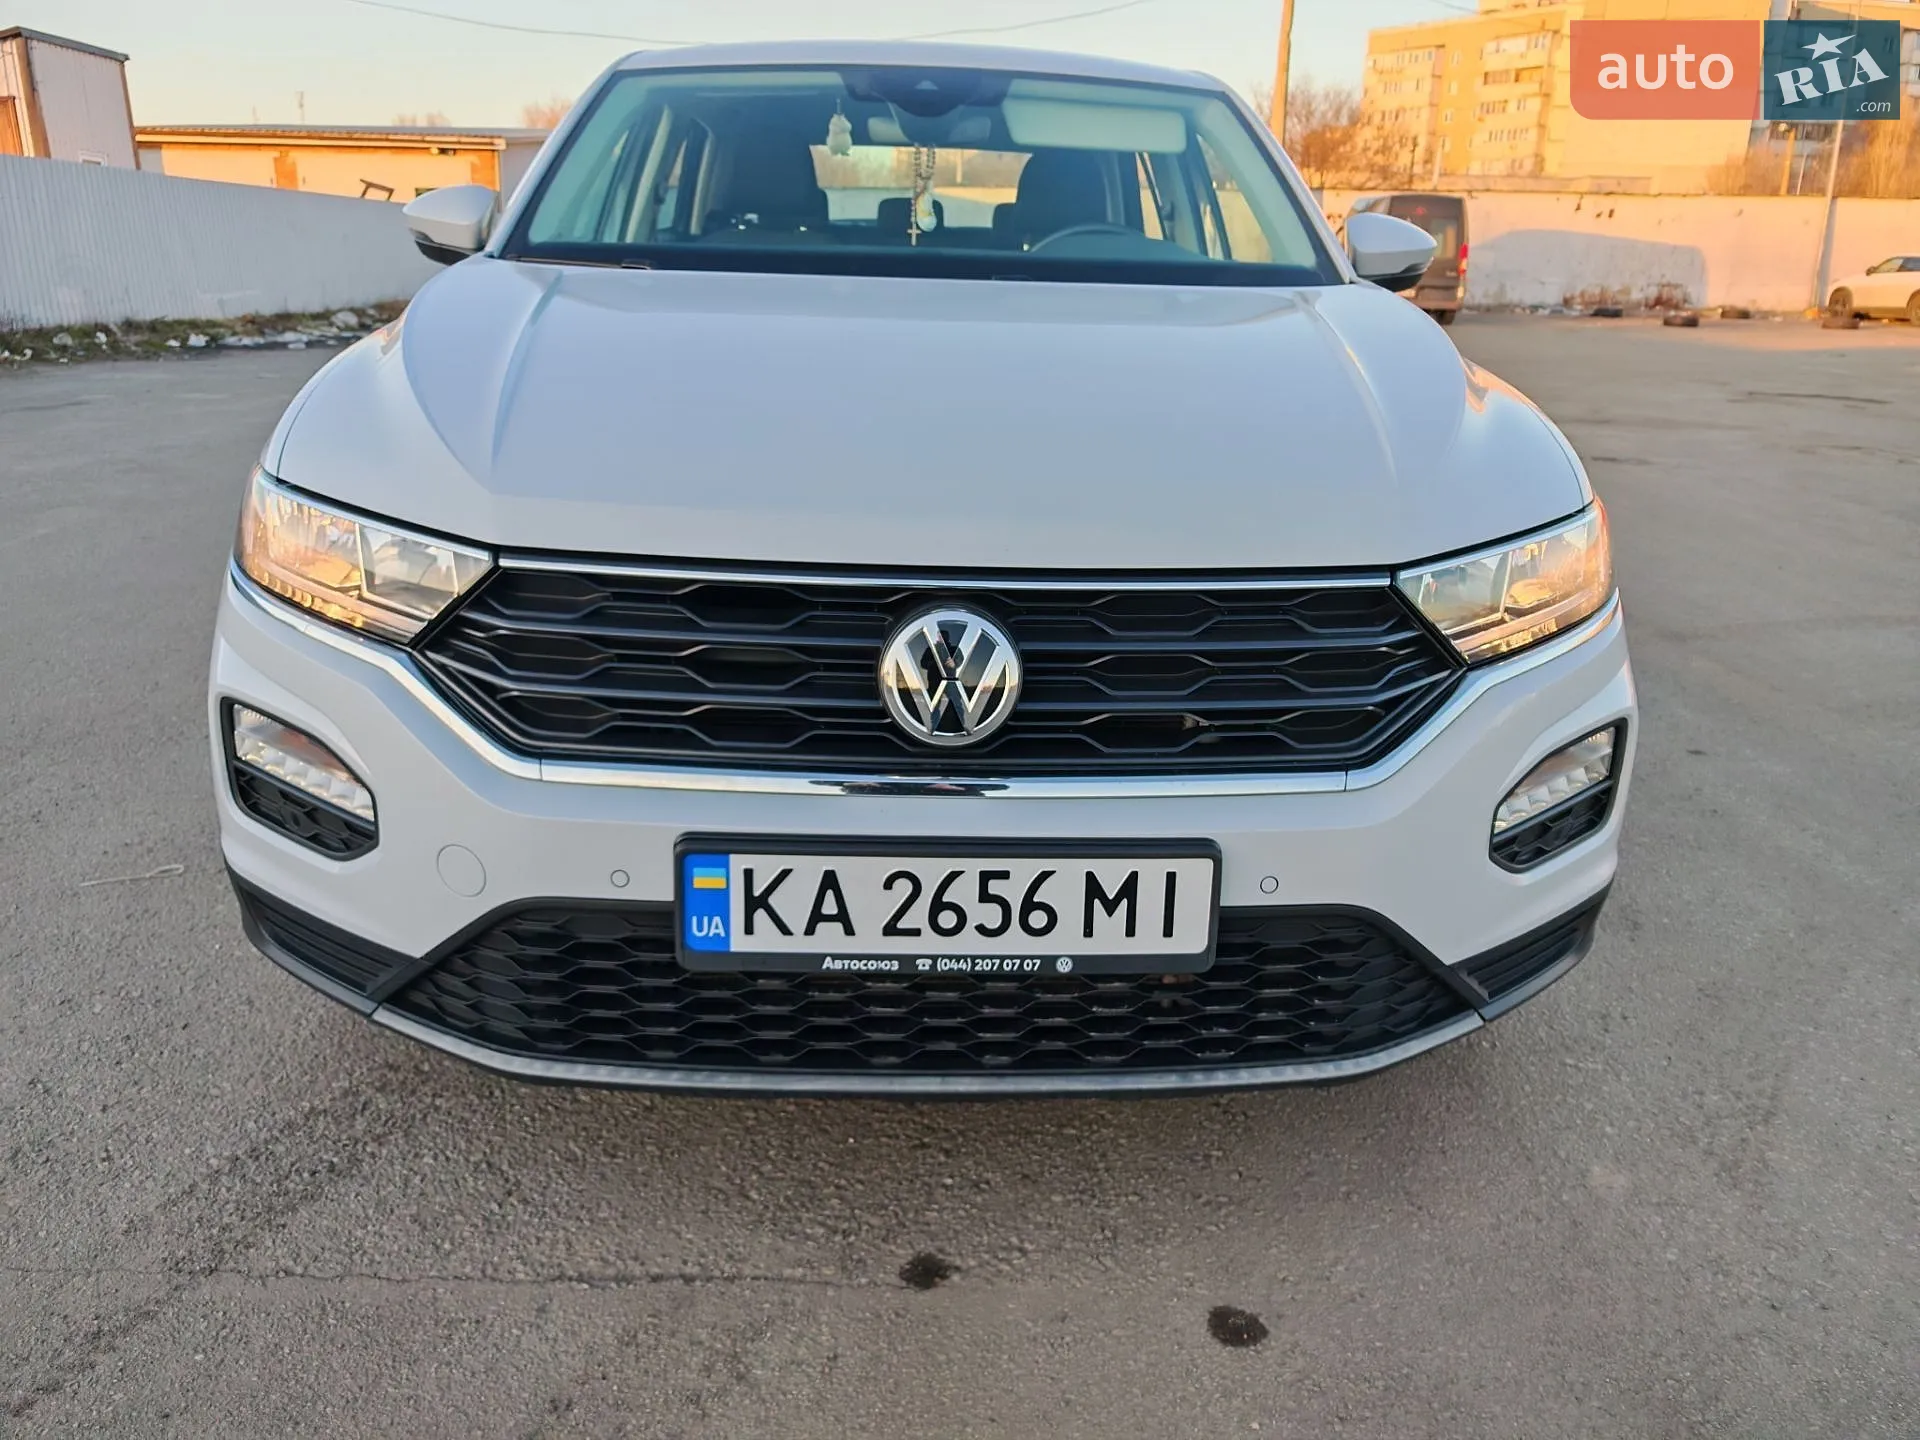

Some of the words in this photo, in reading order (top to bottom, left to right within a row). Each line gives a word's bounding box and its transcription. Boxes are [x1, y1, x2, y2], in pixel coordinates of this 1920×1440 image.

[742, 867, 857, 937] KA
[881, 869, 1059, 938] 2656
[1081, 870, 1178, 939] MI
[691, 915, 726, 938] UA
[936, 957, 972, 972] (044)
[974, 958, 1001, 971] 207
[1002, 958, 1021, 971] 07
[1023, 958, 1041, 971] 07
